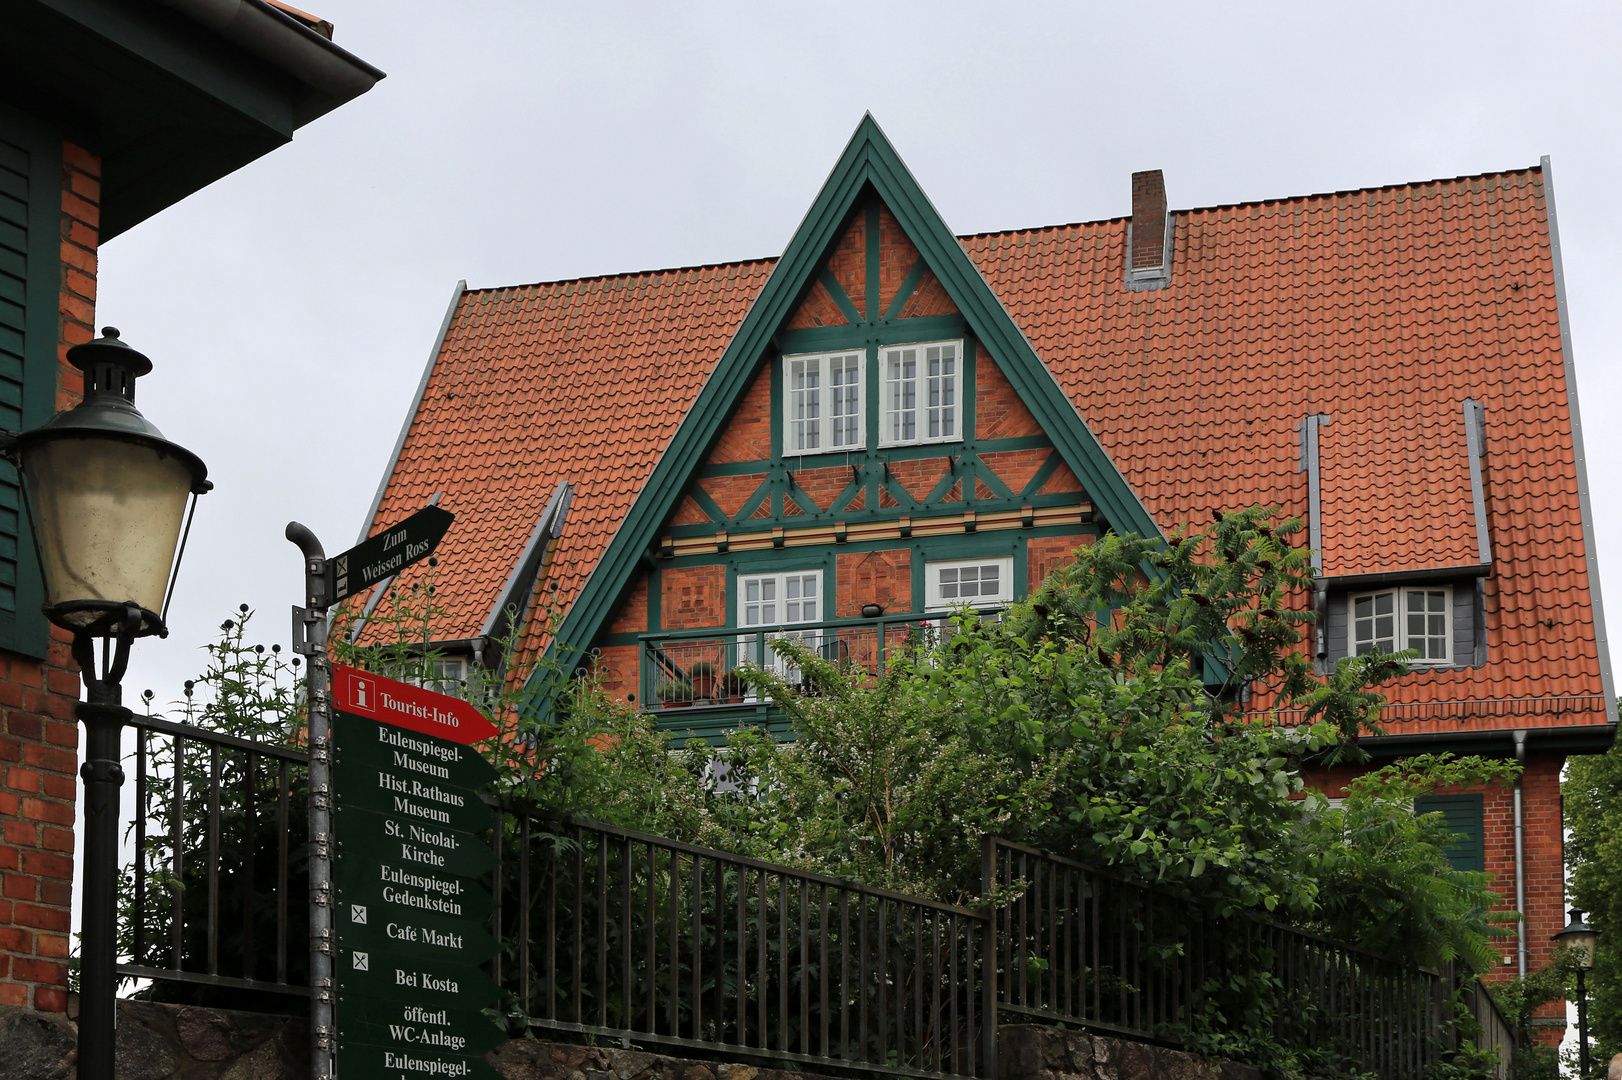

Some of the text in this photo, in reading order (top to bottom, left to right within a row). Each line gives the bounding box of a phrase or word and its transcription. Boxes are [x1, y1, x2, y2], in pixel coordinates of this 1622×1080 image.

[383, 528, 407, 551] Zum
[362, 538, 430, 583] Weissen Ross
[380, 692, 460, 728] Tourist-Info
[378, 726, 463, 762] Eulenspiegel-
[393, 750, 449, 779] Museum
[394, 796, 450, 823] Museum
[384, 819, 460, 850] St. Nicolai-
[401, 843, 445, 867] Kirche
[380, 864, 464, 896] Eulenspiegel-
[382, 886, 462, 916] Gedenkstein
[386, 922, 463, 949] Café Markt
[395, 968, 459, 994] Bei Kosta
[404, 1005, 451, 1026] öffentl.
[389, 1024, 466, 1051] WC-Anlage
[384, 1051, 471, 1078] Eulenspiegel-
